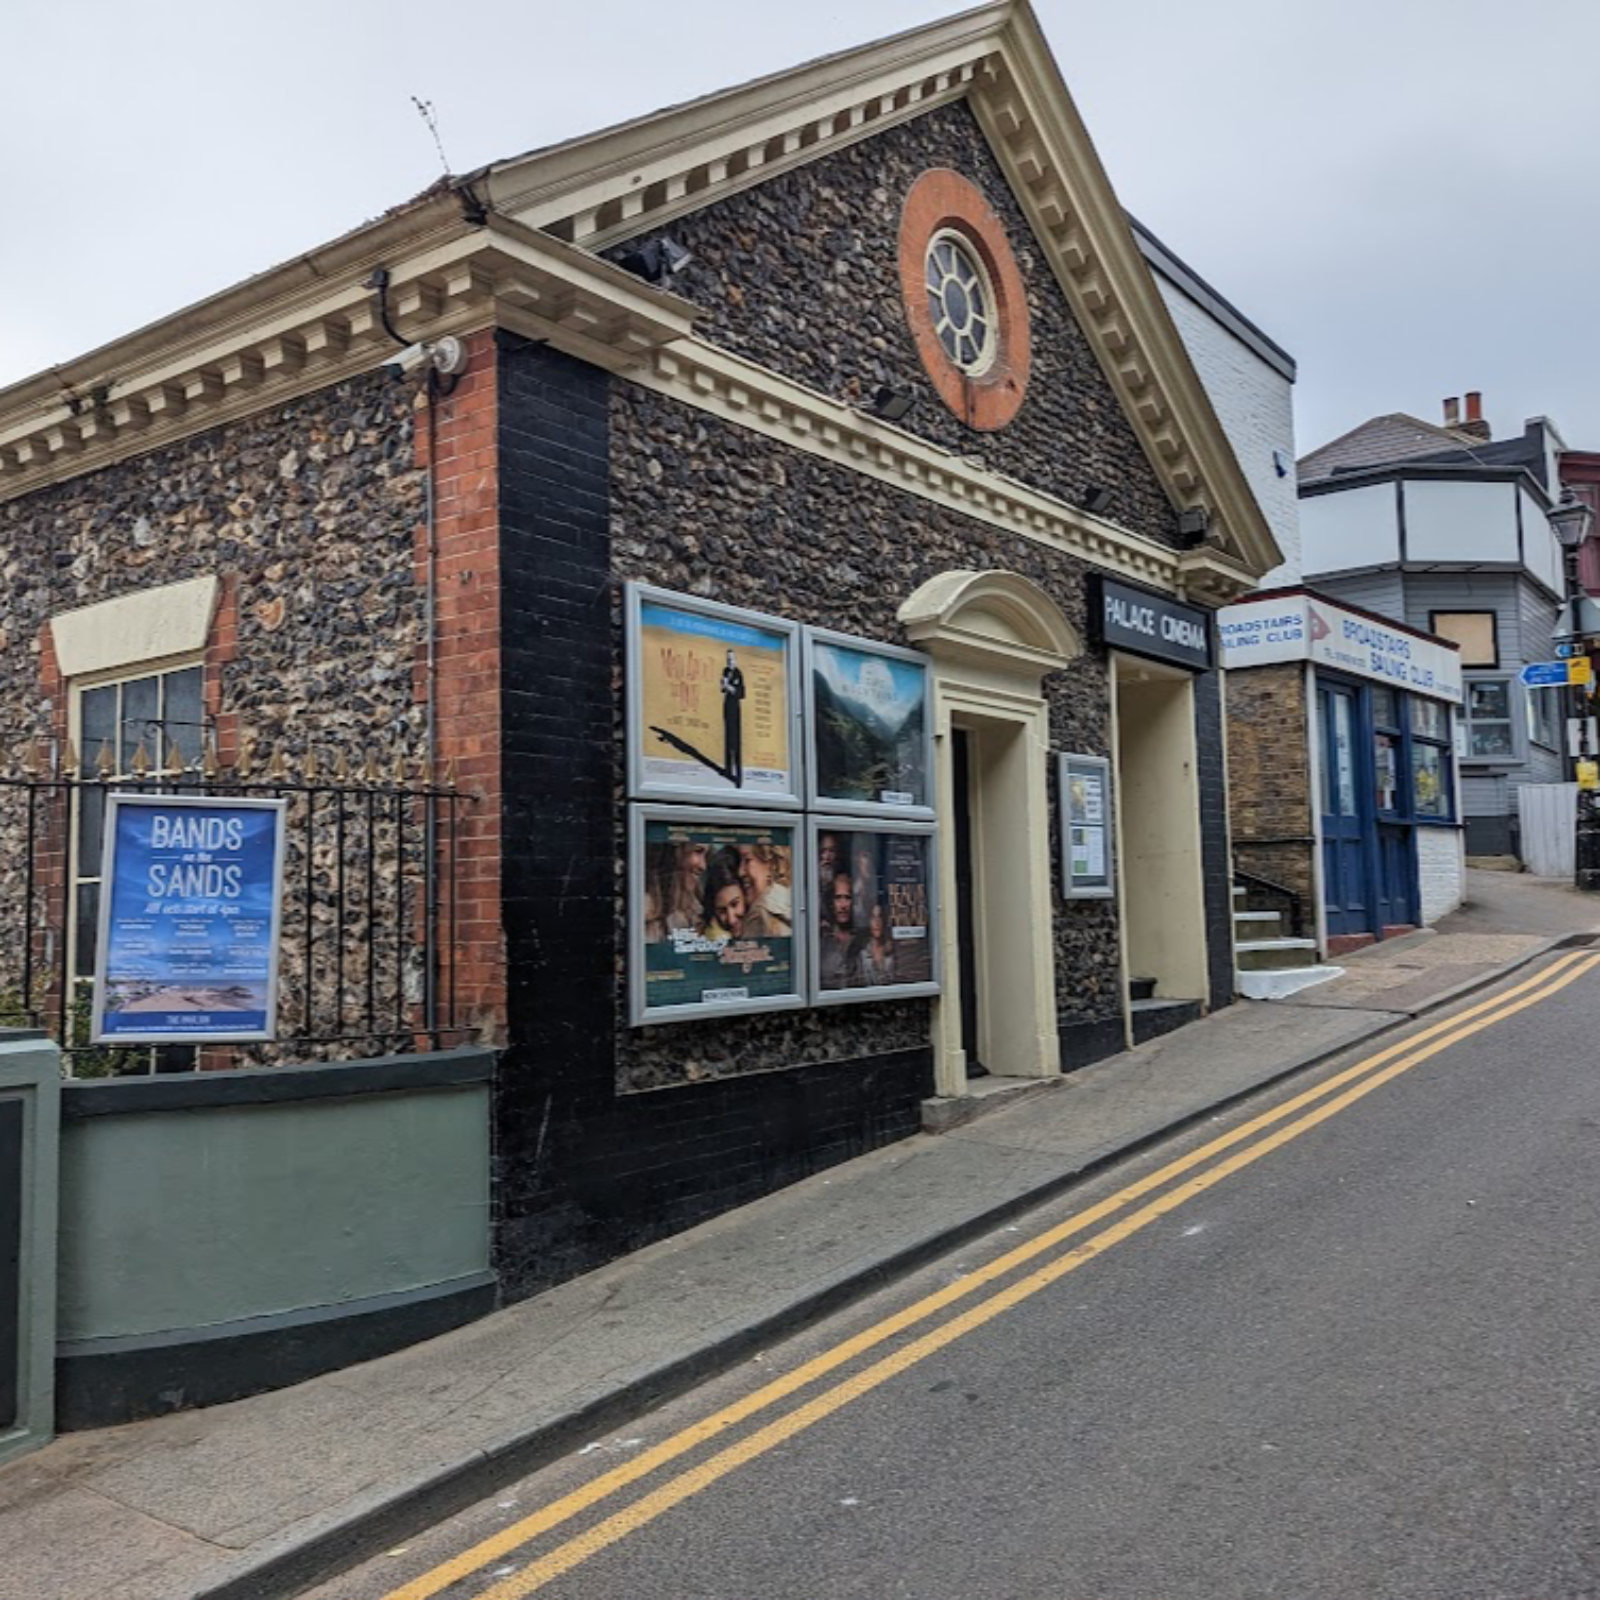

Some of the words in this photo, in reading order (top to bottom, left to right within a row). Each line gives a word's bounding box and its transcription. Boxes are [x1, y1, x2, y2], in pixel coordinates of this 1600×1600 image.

[1105, 595, 1155, 636] PALACE
[1161, 615, 1207, 653] CINEMA
[1220, 614, 1303, 634] ROADSTAIRS
[1266, 629, 1303, 643] CLUB
[1342, 619, 1411, 660] BROADSTAIRS
[1370, 652, 1408, 681] SAILING
[1410, 664, 1434, 688] CLUB
[151, 815, 243, 851] BANDS
[147, 864, 242, 898] SANDS
